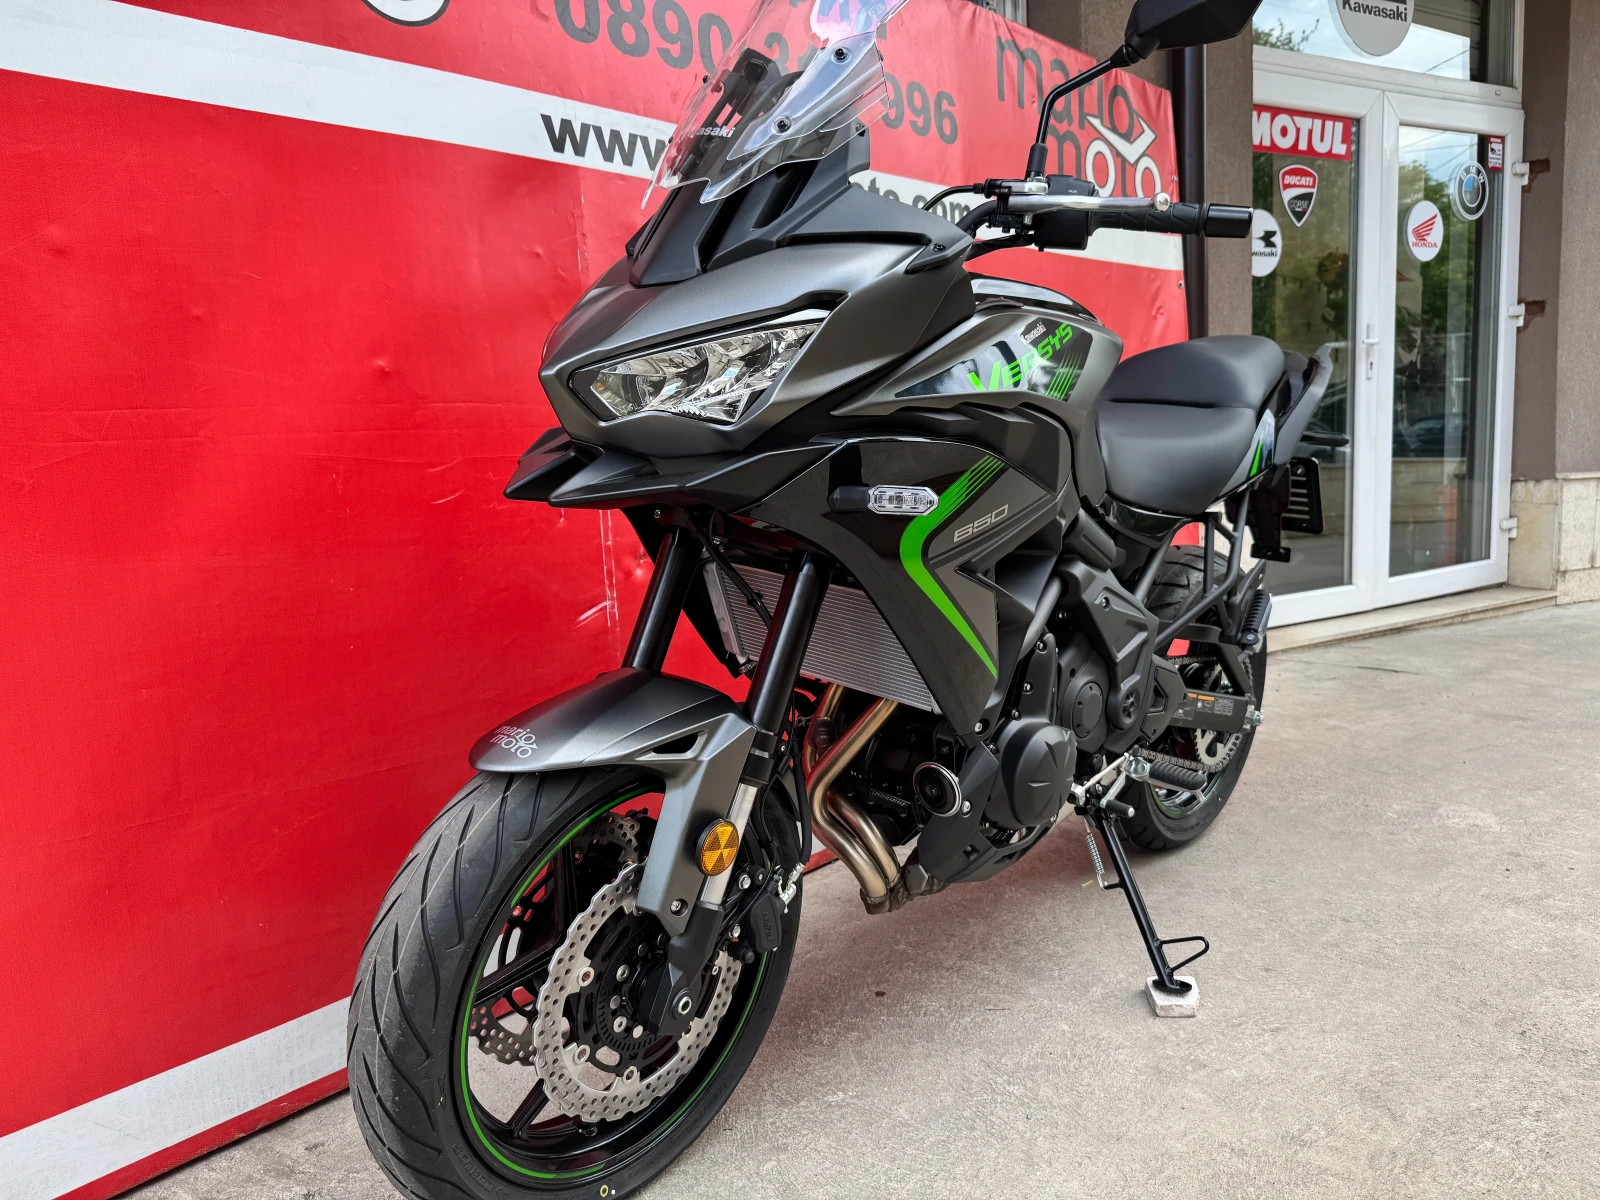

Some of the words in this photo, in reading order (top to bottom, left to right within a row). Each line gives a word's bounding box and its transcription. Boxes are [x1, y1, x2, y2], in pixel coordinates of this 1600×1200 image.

[1342, 0, 1407, 22] Kawasaki
[553, 0, 734, 76] 0890
[880, 71, 958, 145] 996
[996, 35, 1135, 146] mario
[1252, 110, 1348, 156] MOTUL
[1048, 123, 1162, 198] moto
[1284, 174, 1314, 187] DUCATI
[1460, 165, 1485, 184] BMW
[1289, 199, 1310, 209] CORSE
[1412, 241, 1438, 249] HONDA
[1019, 321, 1047, 346] Kawasaki
[966, 321, 1074, 391] VERSYS
[953, 503, 1009, 543] 650
[490, 734, 532, 758] moto
[494, 725, 536, 744] mario
